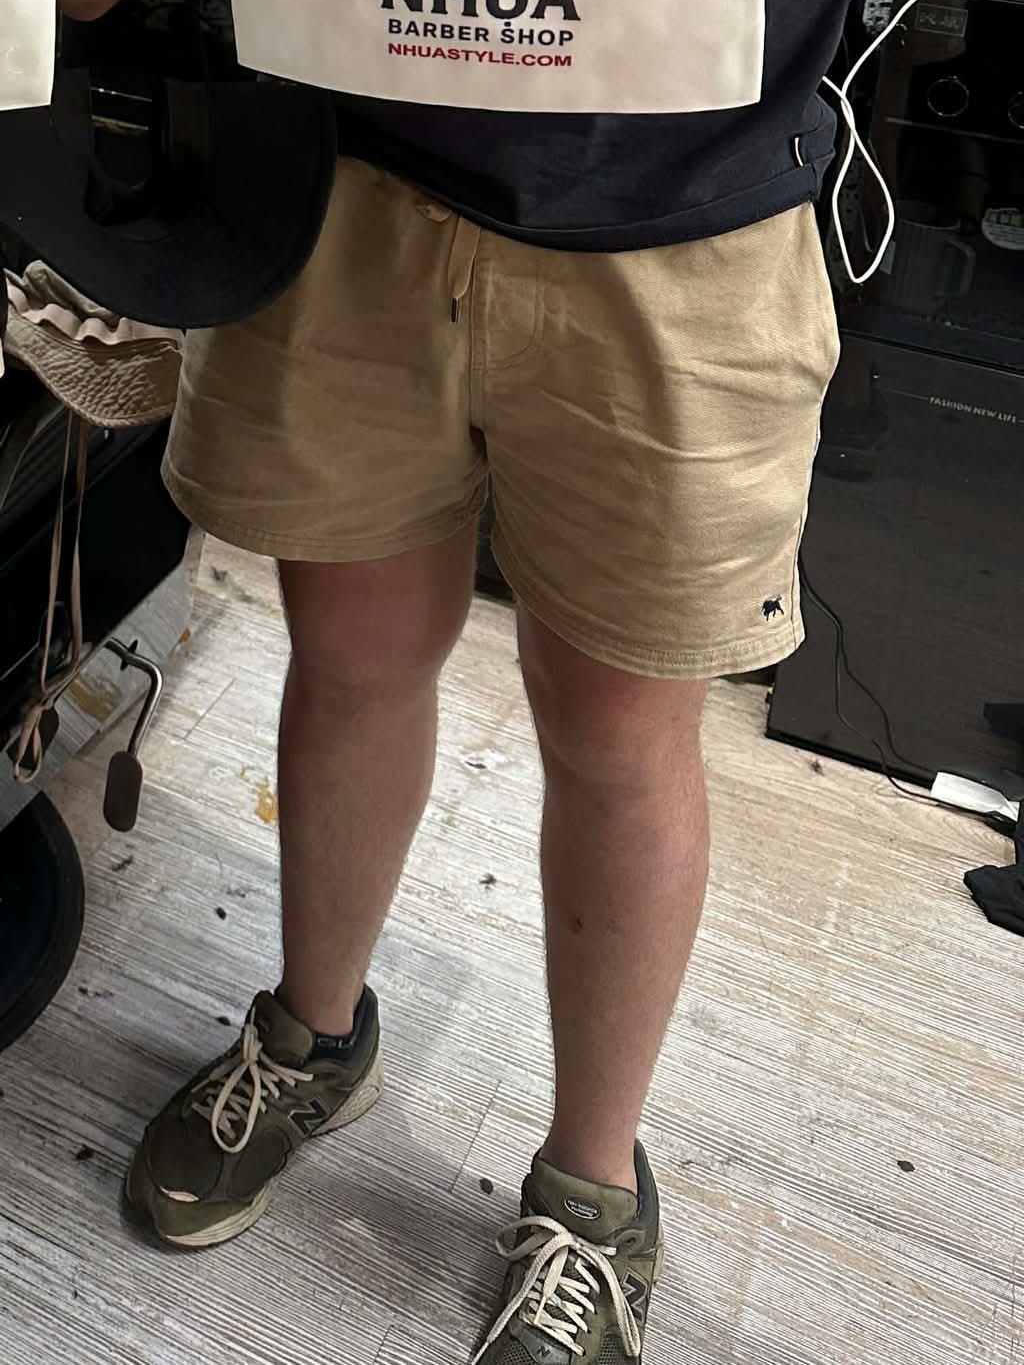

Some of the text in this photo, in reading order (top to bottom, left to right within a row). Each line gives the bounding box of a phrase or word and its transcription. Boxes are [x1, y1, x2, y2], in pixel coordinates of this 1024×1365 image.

[388, 19, 574, 46] BARBER SHOP
[388, 43, 572, 67] NHUASTYLE.COM
[929, 397, 1016, 423] FASHION NEW LIFE
